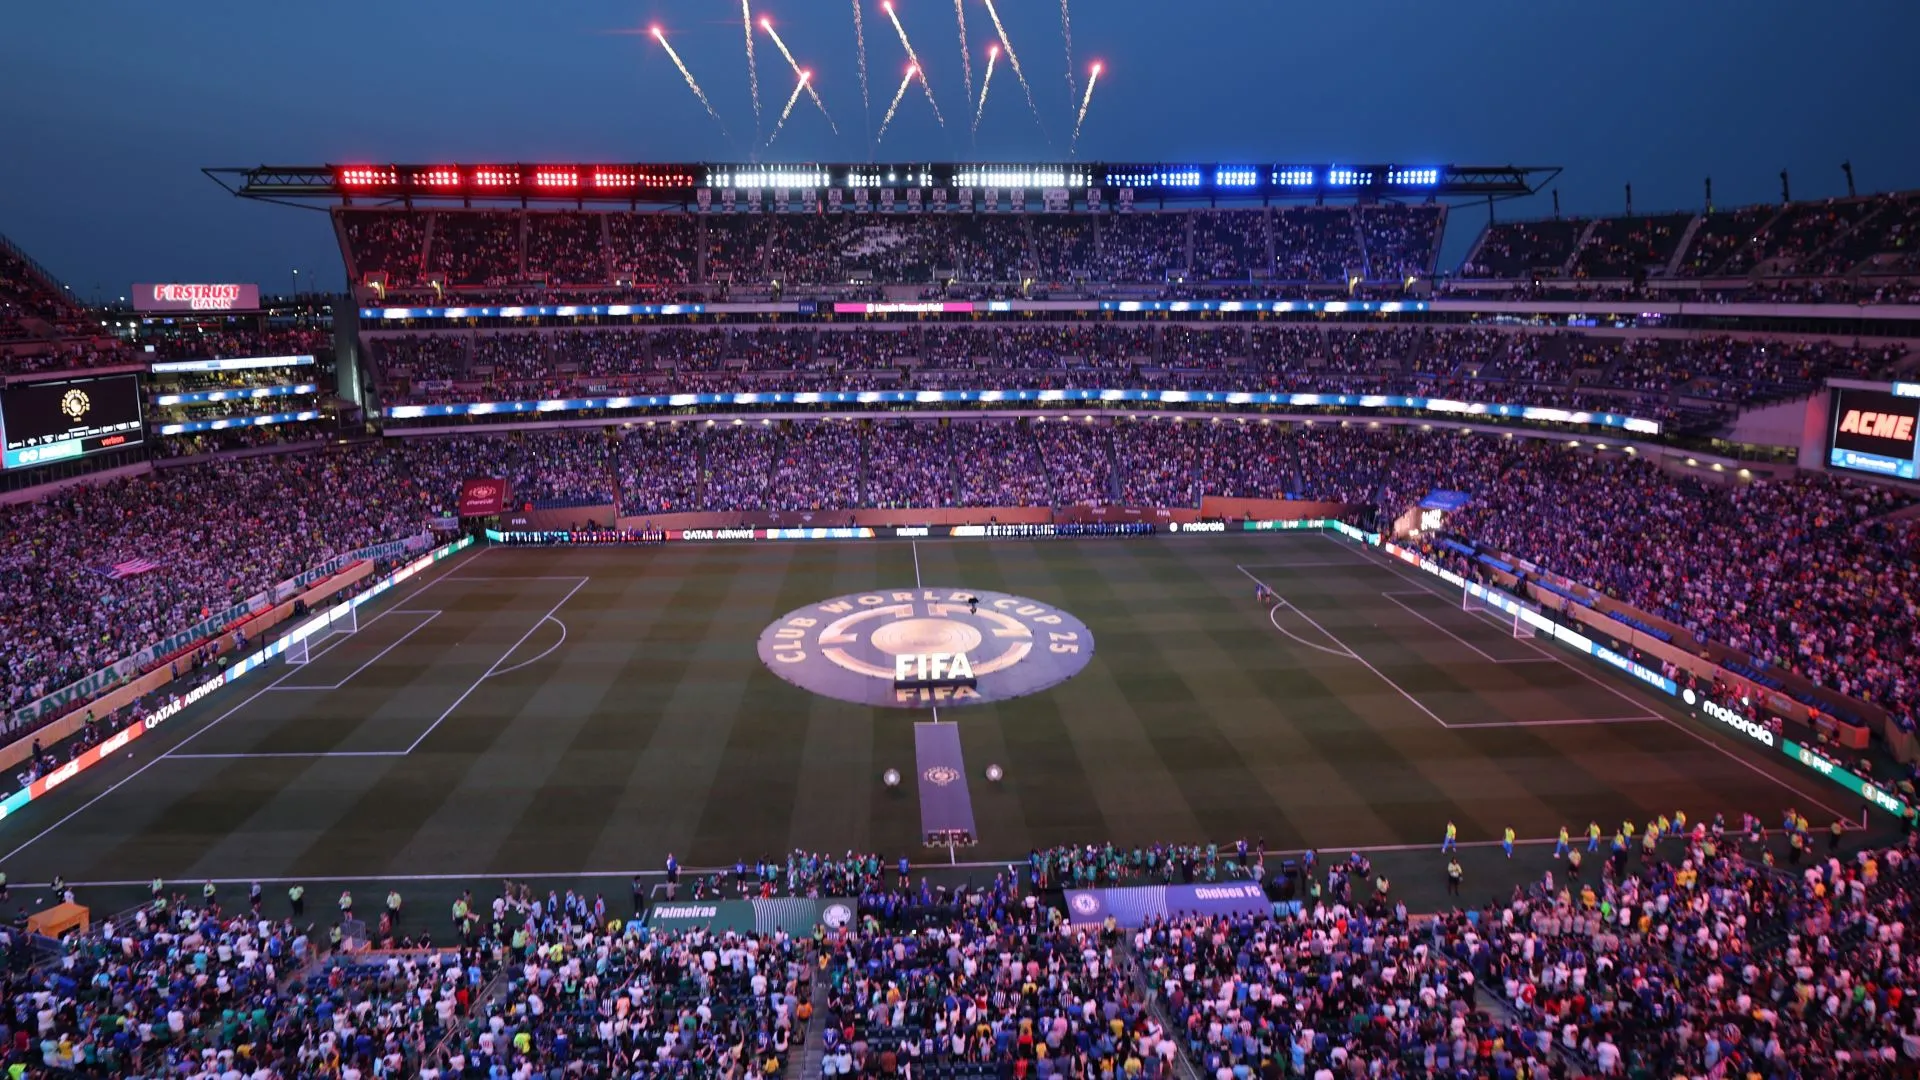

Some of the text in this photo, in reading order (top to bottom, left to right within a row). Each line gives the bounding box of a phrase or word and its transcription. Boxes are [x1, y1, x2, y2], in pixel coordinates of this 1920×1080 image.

[191, 299, 233, 309] BANK
[1156, 509, 1170, 517] FIFA
[682, 529, 754, 539] QATAR AIRWAYS
[1183, 522, 1224, 532] motorola
[293, 556, 345, 588] VERDE
[772, 591, 1079, 664] CLUB WORLD CUP 25
[895, 653, 974, 681] FIFA
[1634, 664, 1665, 688] ULTRA
[145, 674, 224, 729] QATAR AIRWAYS
[896, 685, 982, 702] FIFA
[1703, 700, 1773, 747] motorola
[1812, 755, 1833, 775] PIF
[1876, 791, 1899, 811] PIF
[1195, 885, 1261, 899] Chelsea FC
[654, 905, 717, 919] Palmeiras
